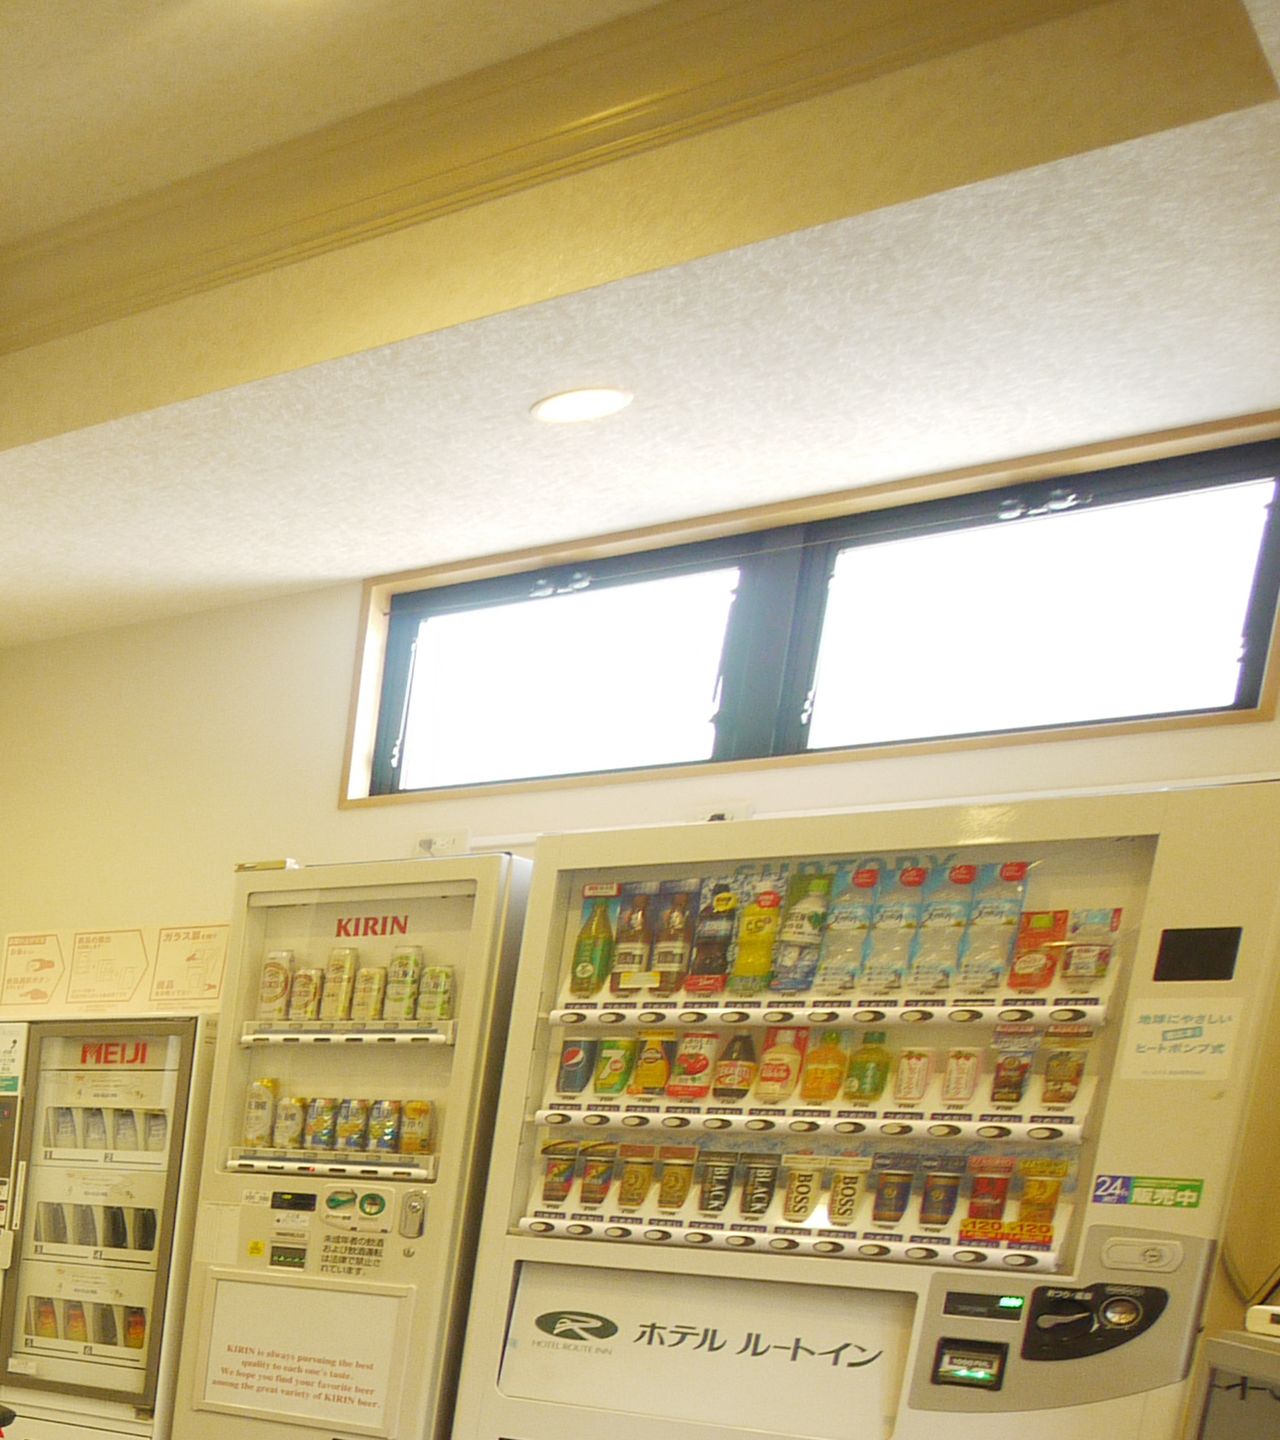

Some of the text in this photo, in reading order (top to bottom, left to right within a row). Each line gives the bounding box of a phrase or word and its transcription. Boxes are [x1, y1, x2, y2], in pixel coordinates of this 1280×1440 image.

[335, 915, 408, 938] KIRIN
[81, 1043, 148, 1065] MEIJI
[708, 1167, 729, 1210] BLACK
[750, 1169, 772, 1212] BLACK
[792, 1173, 813, 1214] BOSS
[838, 1176, 858, 1217] BOSS
[1134, 1187, 1198, 1205] 販売中
[322, 1245, 383, 1258] および飲酒運転
[324, 1234, 384, 1248] 未成年者の飲酒
[227, 1344, 255, 1355] KIRIN
[257, 1348, 264, 1356] is
[267, 1350, 295, 1361] always
[339, 1358, 353, 1368] the
[355, 1360, 374, 1370] best
[532, 1339, 561, 1350] HOTEL
[562, 1342, 590, 1353] ROUTE
[633, 1322, 883, 1368] ホテル ルートイン
[241, 1359, 270, 1370] quality
[273, 1362, 281, 1370] to
[283, 1364, 303, 1374] each
[212, 1379, 239, 1390] among
[241, 1381, 254, 1390] the
[256, 1384, 278, 1395] great
[280, 1387, 310, 1399] variety
[313, 1391, 321, 1400] of
[324, 1394, 355, 1405] KIRIN
[221, 1366, 375, 1396] We hope you find your favorite beer
